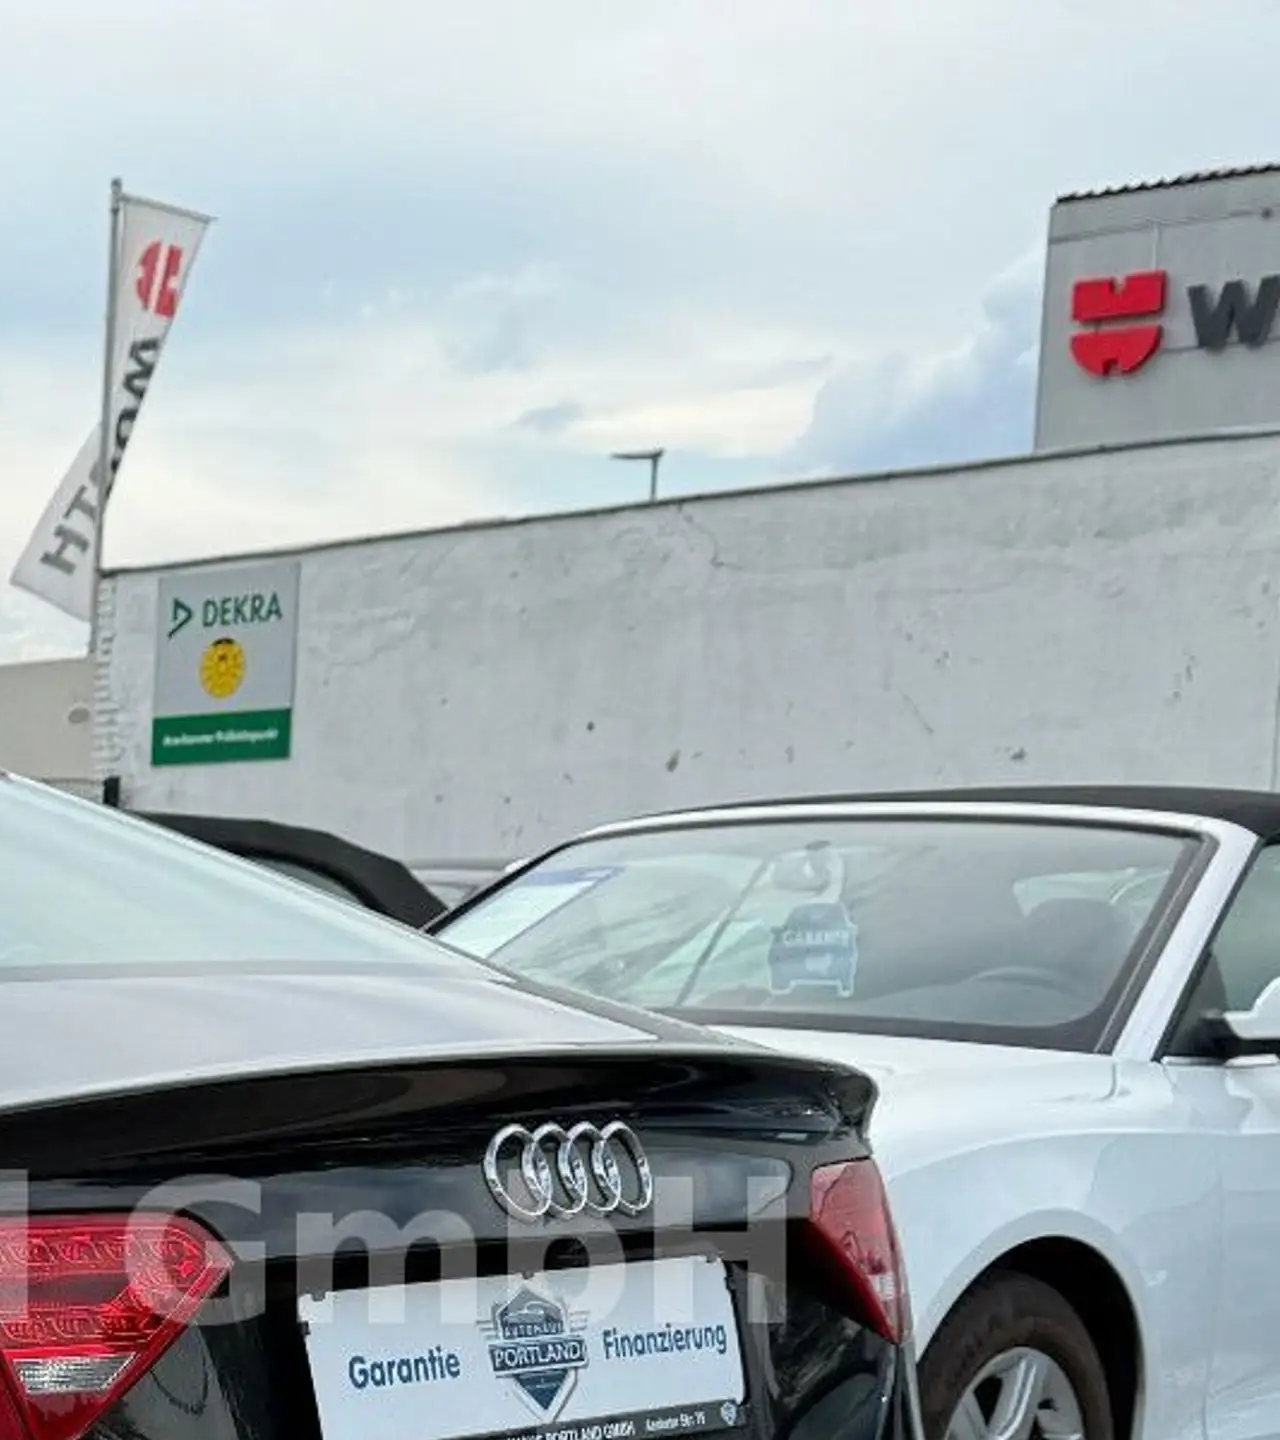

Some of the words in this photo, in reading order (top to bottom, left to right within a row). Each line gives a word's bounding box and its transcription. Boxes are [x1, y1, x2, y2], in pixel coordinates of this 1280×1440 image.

[202, 592, 283, 628] DEKRA
[494, 1341, 582, 1368] PORTLAND
[602, 1323, 728, 1359] Finanzierung
[348, 1346, 461, 1389] Garantie
